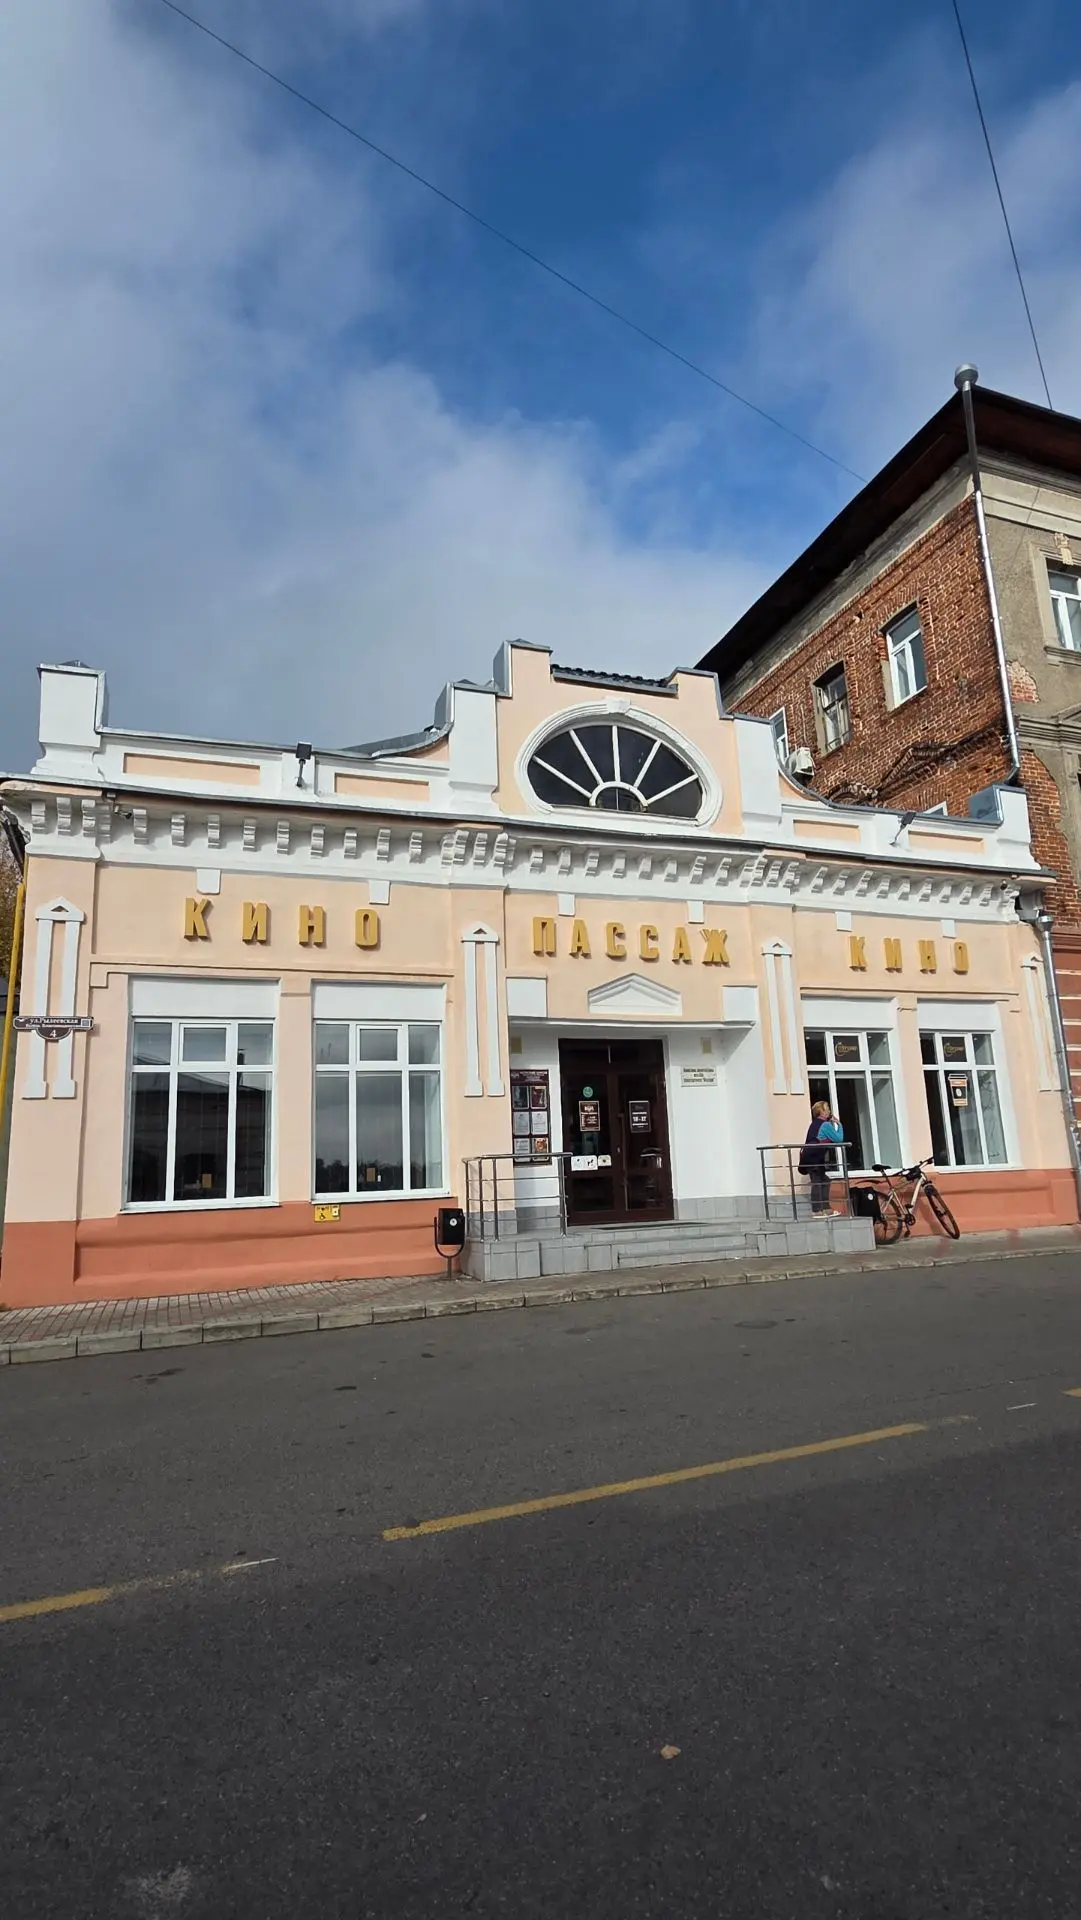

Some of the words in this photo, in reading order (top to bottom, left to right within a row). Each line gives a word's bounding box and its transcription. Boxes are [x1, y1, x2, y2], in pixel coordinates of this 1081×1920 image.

[184, 897, 380, 948] КИНО
[532, 917, 730, 966] ПАССАЖ
[849, 936, 970, 974] КИНО
[49, 1029, 57, 1038] 4
